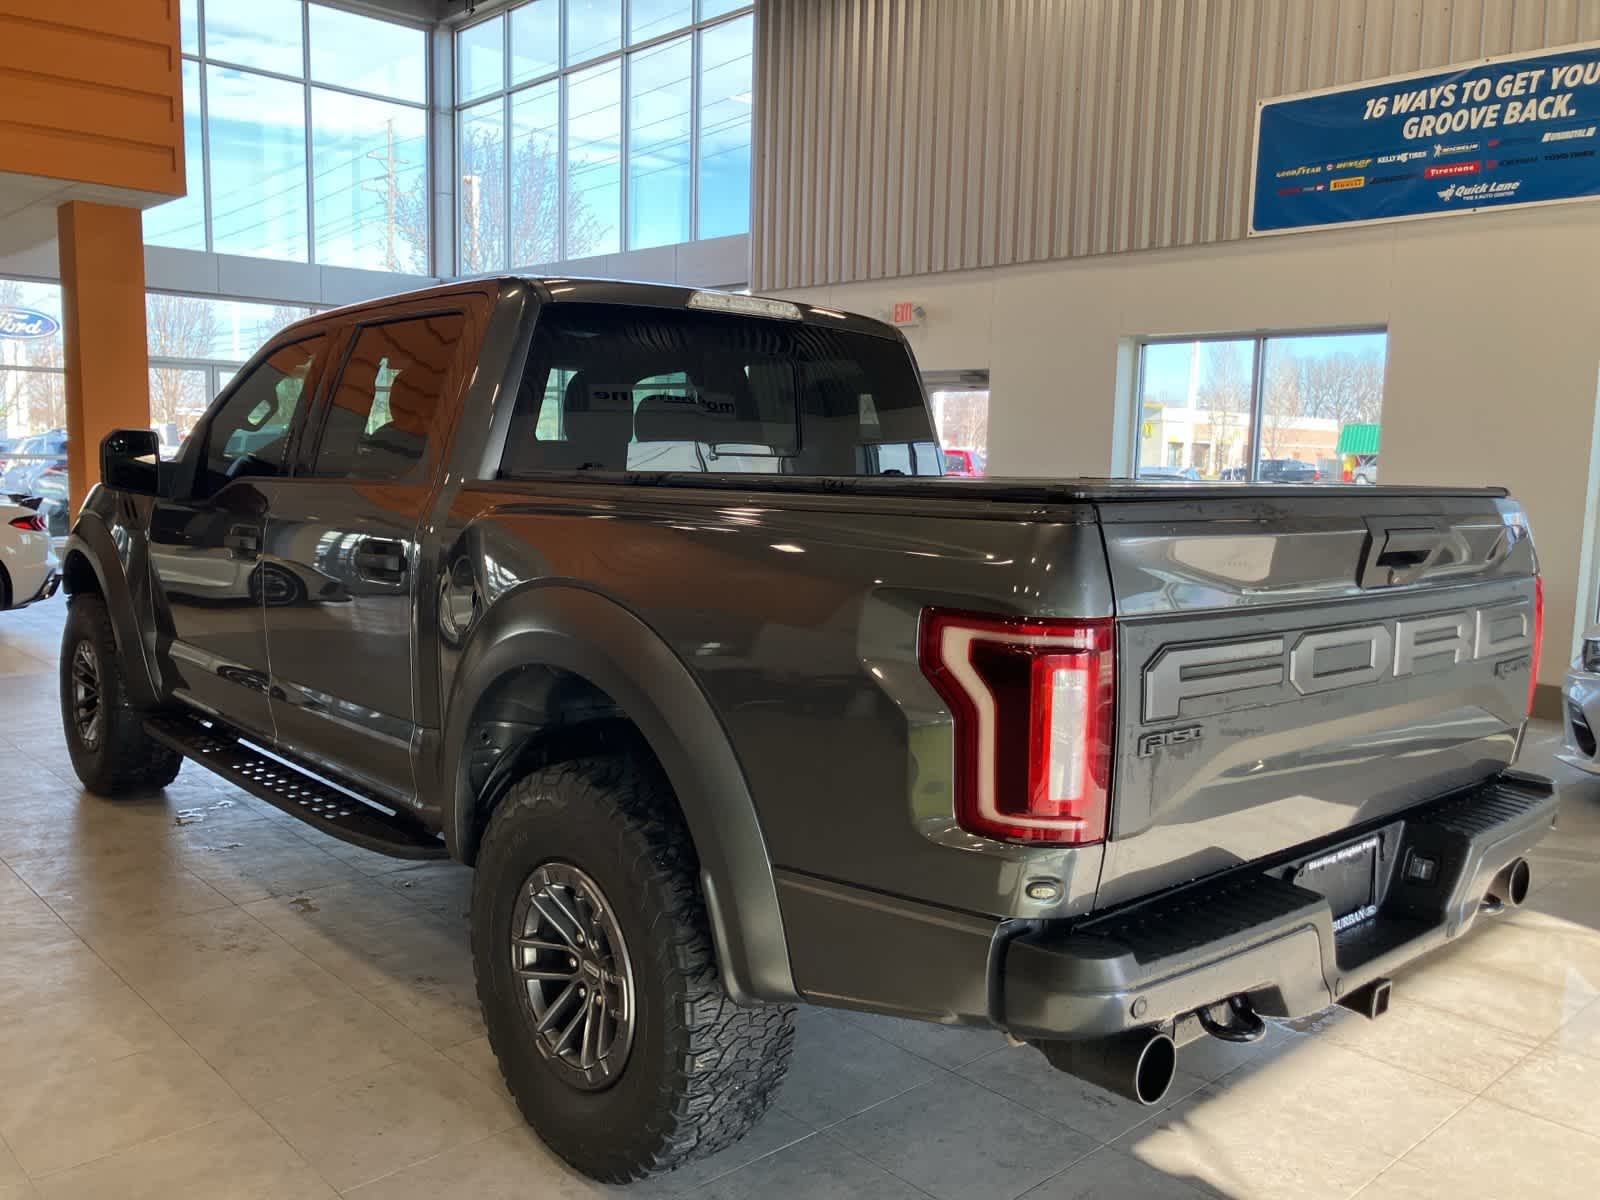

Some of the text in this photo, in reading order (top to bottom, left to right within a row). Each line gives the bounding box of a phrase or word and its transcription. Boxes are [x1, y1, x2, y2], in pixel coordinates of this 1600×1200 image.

[1363, 97, 1388, 120] 16
[1391, 84, 1457, 115] WAYS
[1462, 78, 1491, 104] TO
[1495, 69, 1545, 98] GET
[1402, 104, 1501, 139] GROOVE
[1503, 93, 1576, 125] BACK.
[1455, 181, 1521, 197] Quick Lane
[1141, 598, 1530, 725] FORD
